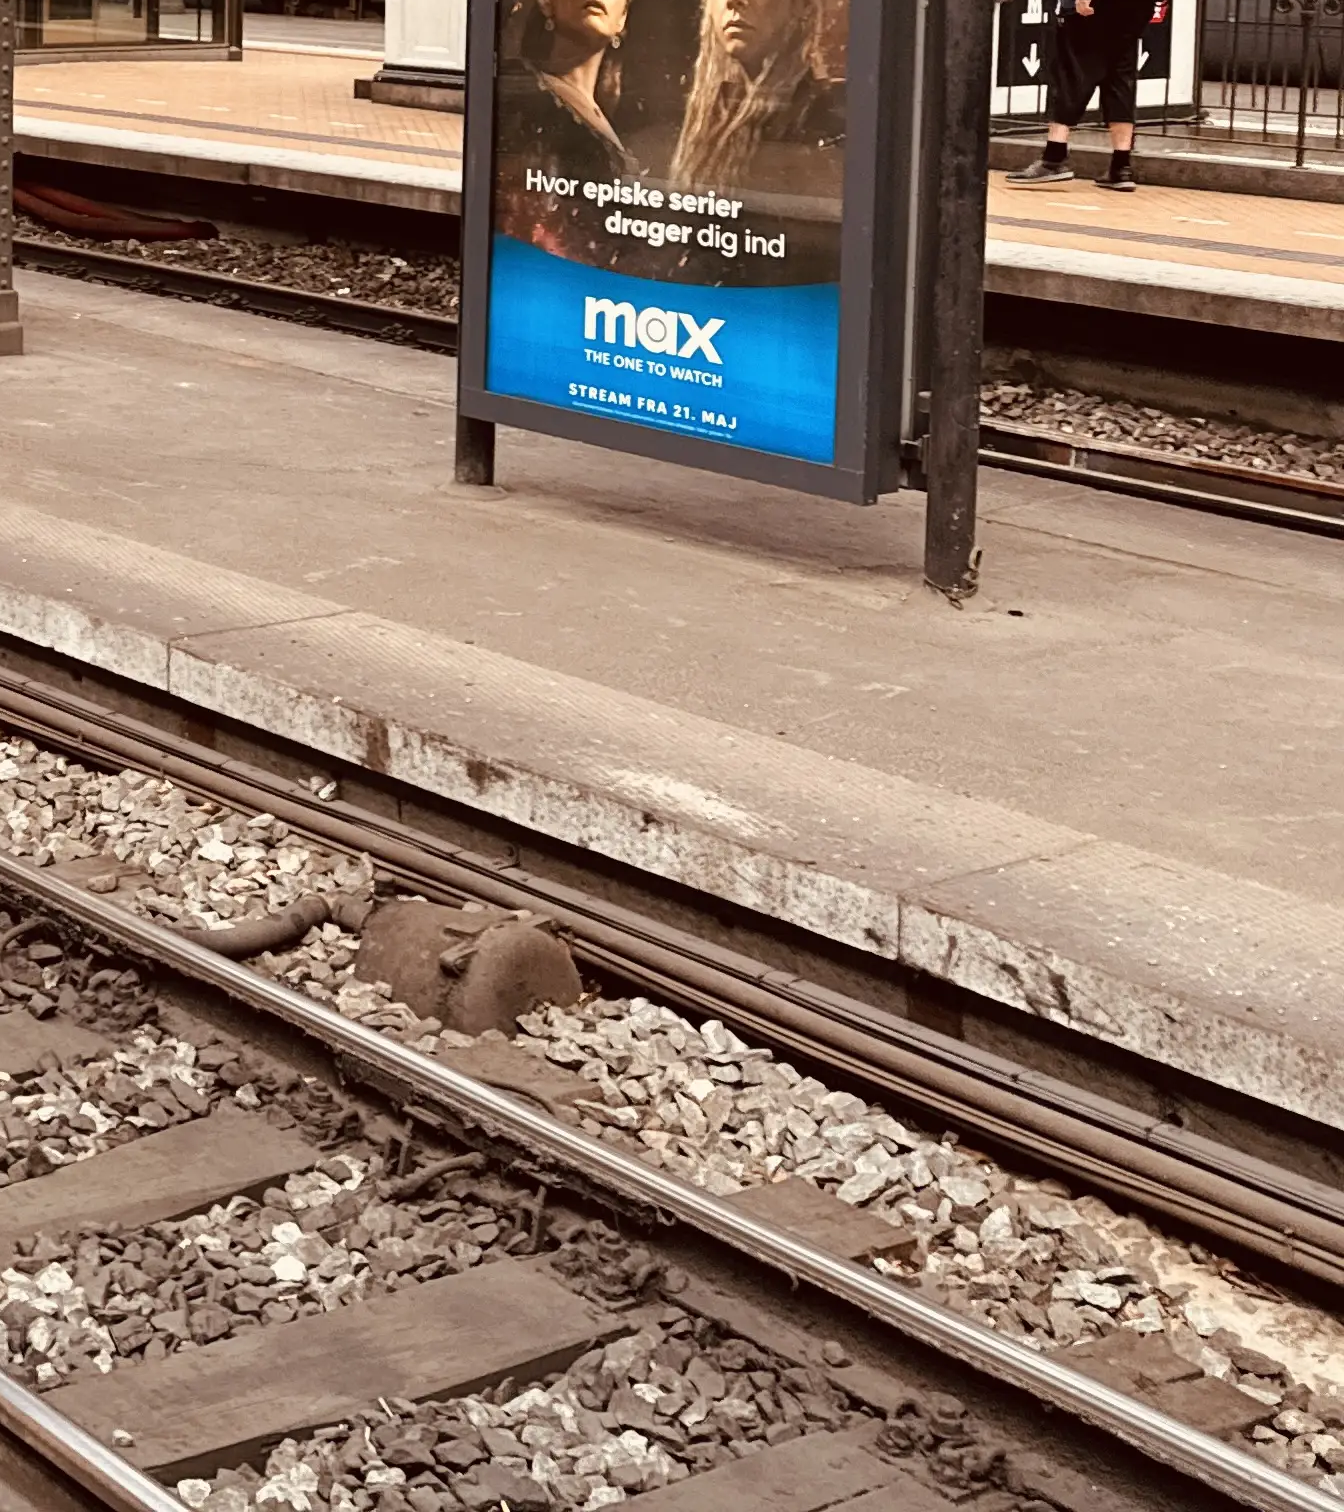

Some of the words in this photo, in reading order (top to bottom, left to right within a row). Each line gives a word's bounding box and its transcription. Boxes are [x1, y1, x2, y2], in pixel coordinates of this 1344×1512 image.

[525, 168, 580, 197] Hvor
[582, 178, 665, 208] episke
[668, 190, 743, 219] serier
[604, 210, 693, 247] drager
[696, 223, 738, 258] dig
[744, 229, 786, 258] ind
[584, 295, 727, 365] max
[583, 348, 611, 366] THE
[613, 355, 644, 373] ONE
[646, 360, 667, 377] TO
[669, 365, 723, 388] WATCH
[568, 382, 631, 408] STREAM
[637, 396, 668, 415] FRA
[673, 404, 696, 421] 21.
[701, 410, 737, 430] MAJ
